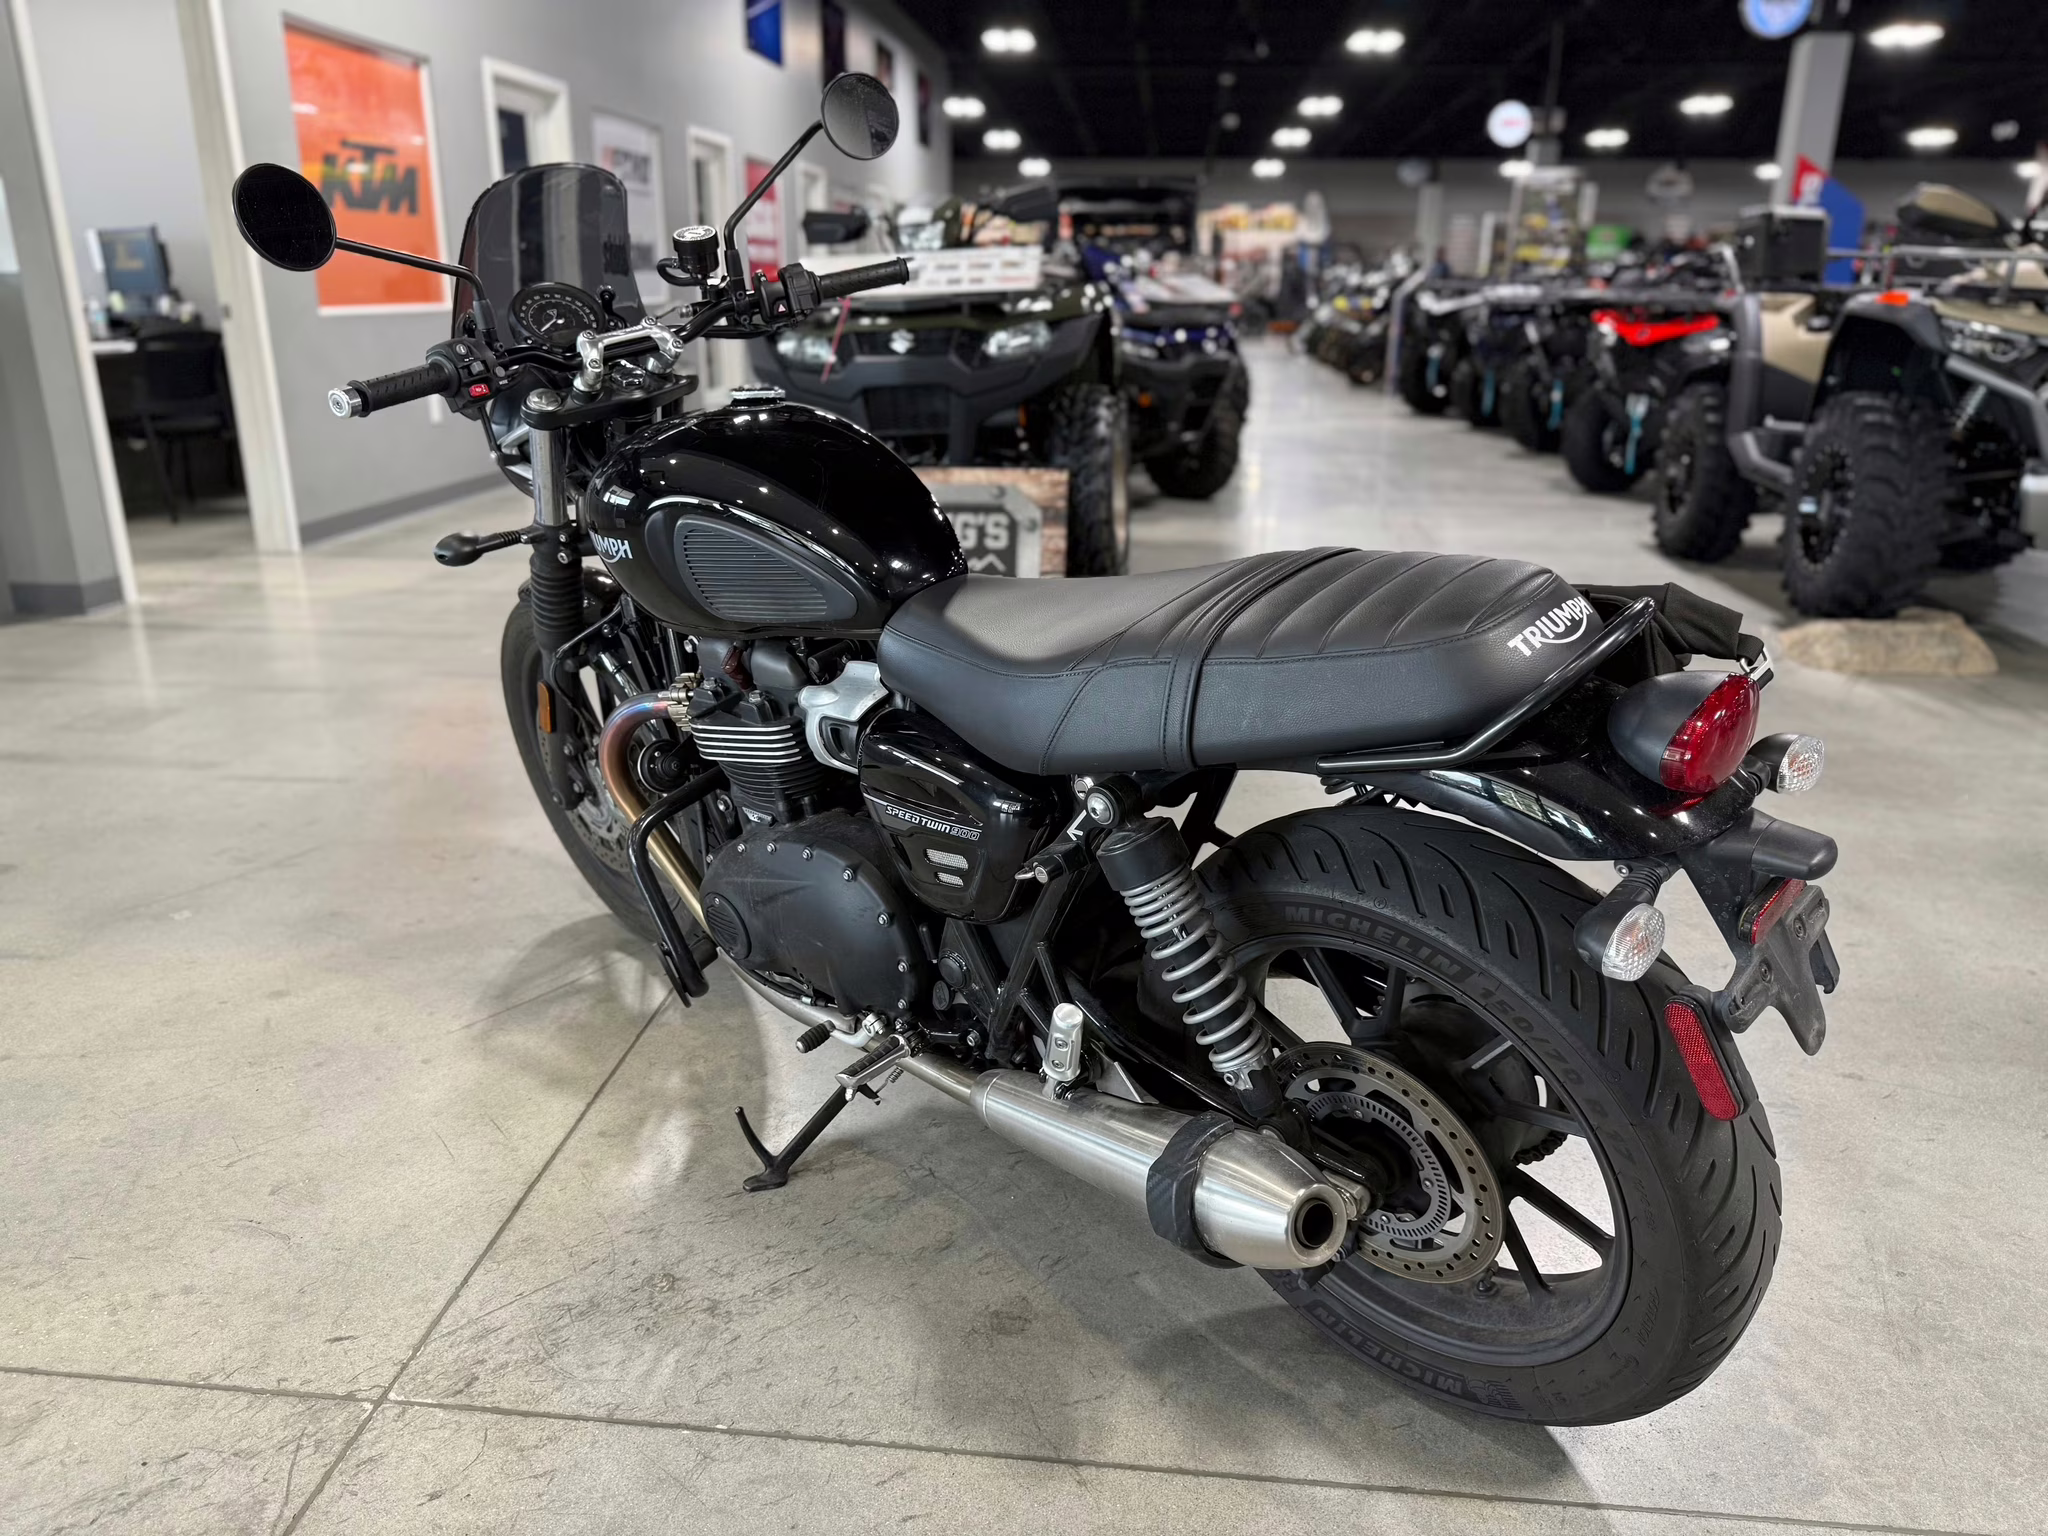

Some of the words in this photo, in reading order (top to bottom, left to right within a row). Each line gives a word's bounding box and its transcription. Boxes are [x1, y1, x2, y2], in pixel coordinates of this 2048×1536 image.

[321, 139, 419, 216] KTM
[1507, 596, 1594, 657] TRIUMPH
[885, 806, 920, 824] SPEED
[921, 817, 951, 834] TWIN
[949, 826, 981, 841] 900
[1284, 906, 1462, 977] MICHELIN
[1312, 1305, 1465, 1396] MICHELIN
